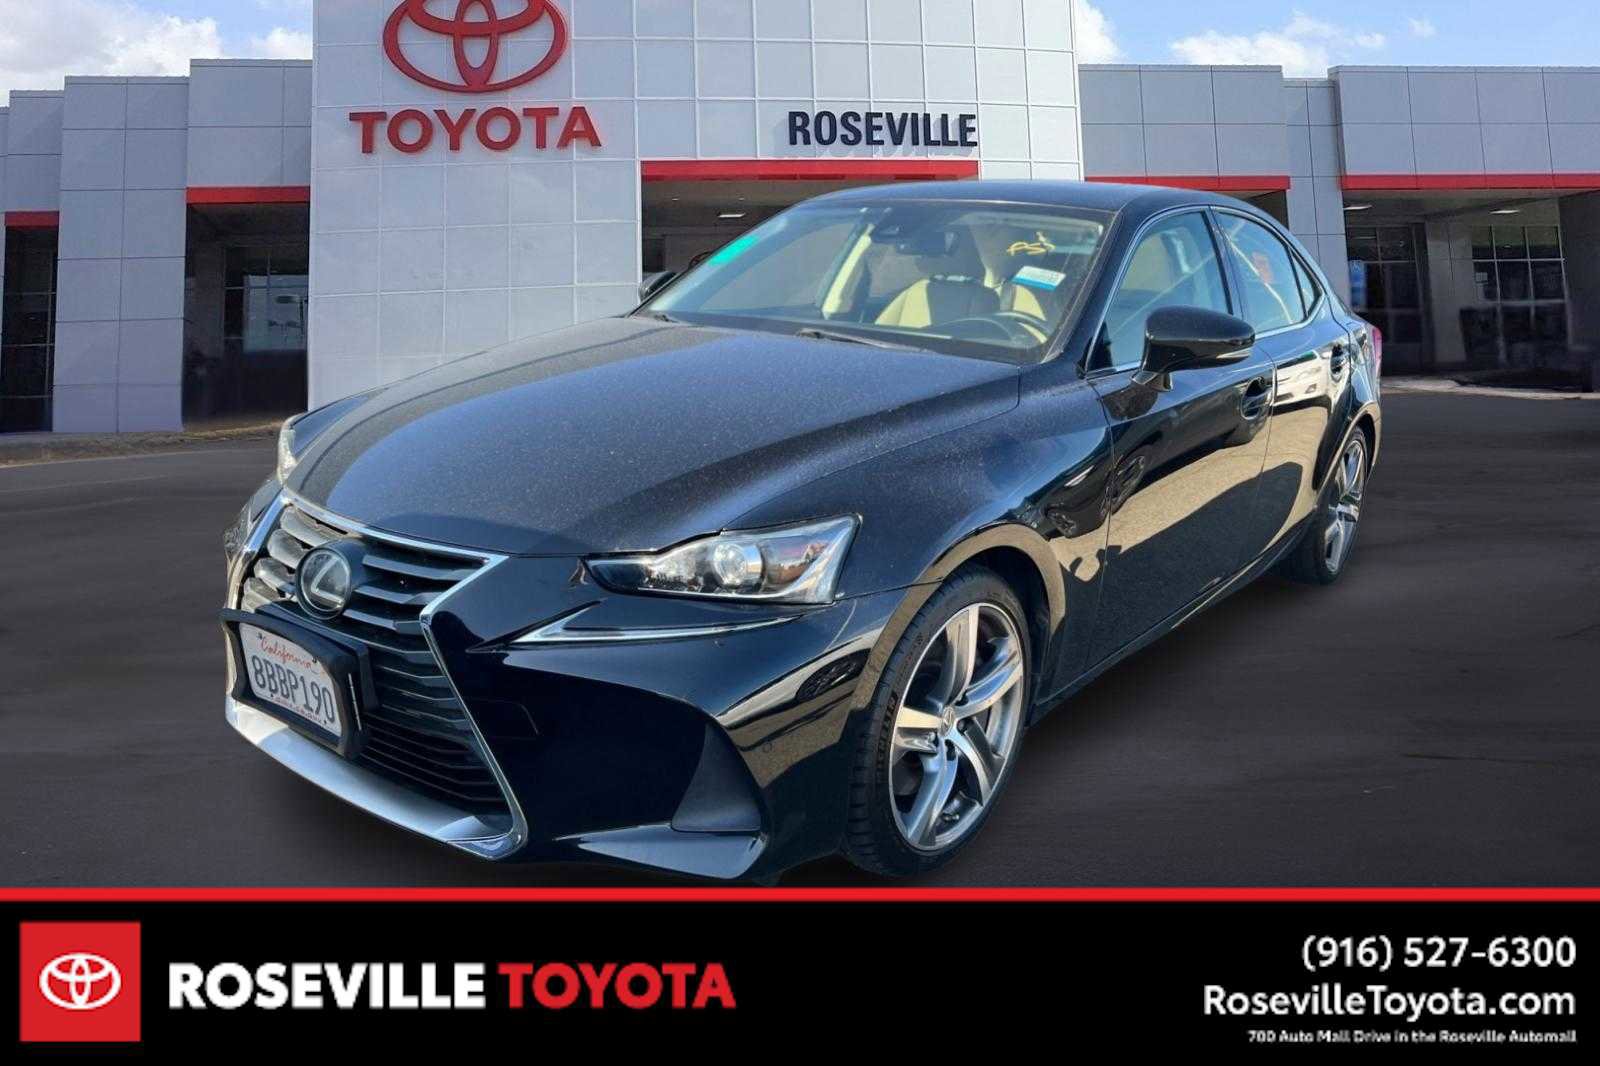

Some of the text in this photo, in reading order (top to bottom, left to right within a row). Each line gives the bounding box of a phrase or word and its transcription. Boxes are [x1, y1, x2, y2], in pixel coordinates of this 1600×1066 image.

[349, 105, 602, 154] TOYOTA
[788, 110, 978, 147] ROSEVILLE
[259, 635, 313, 669] California
[251, 655, 335, 724] 8BBP190
